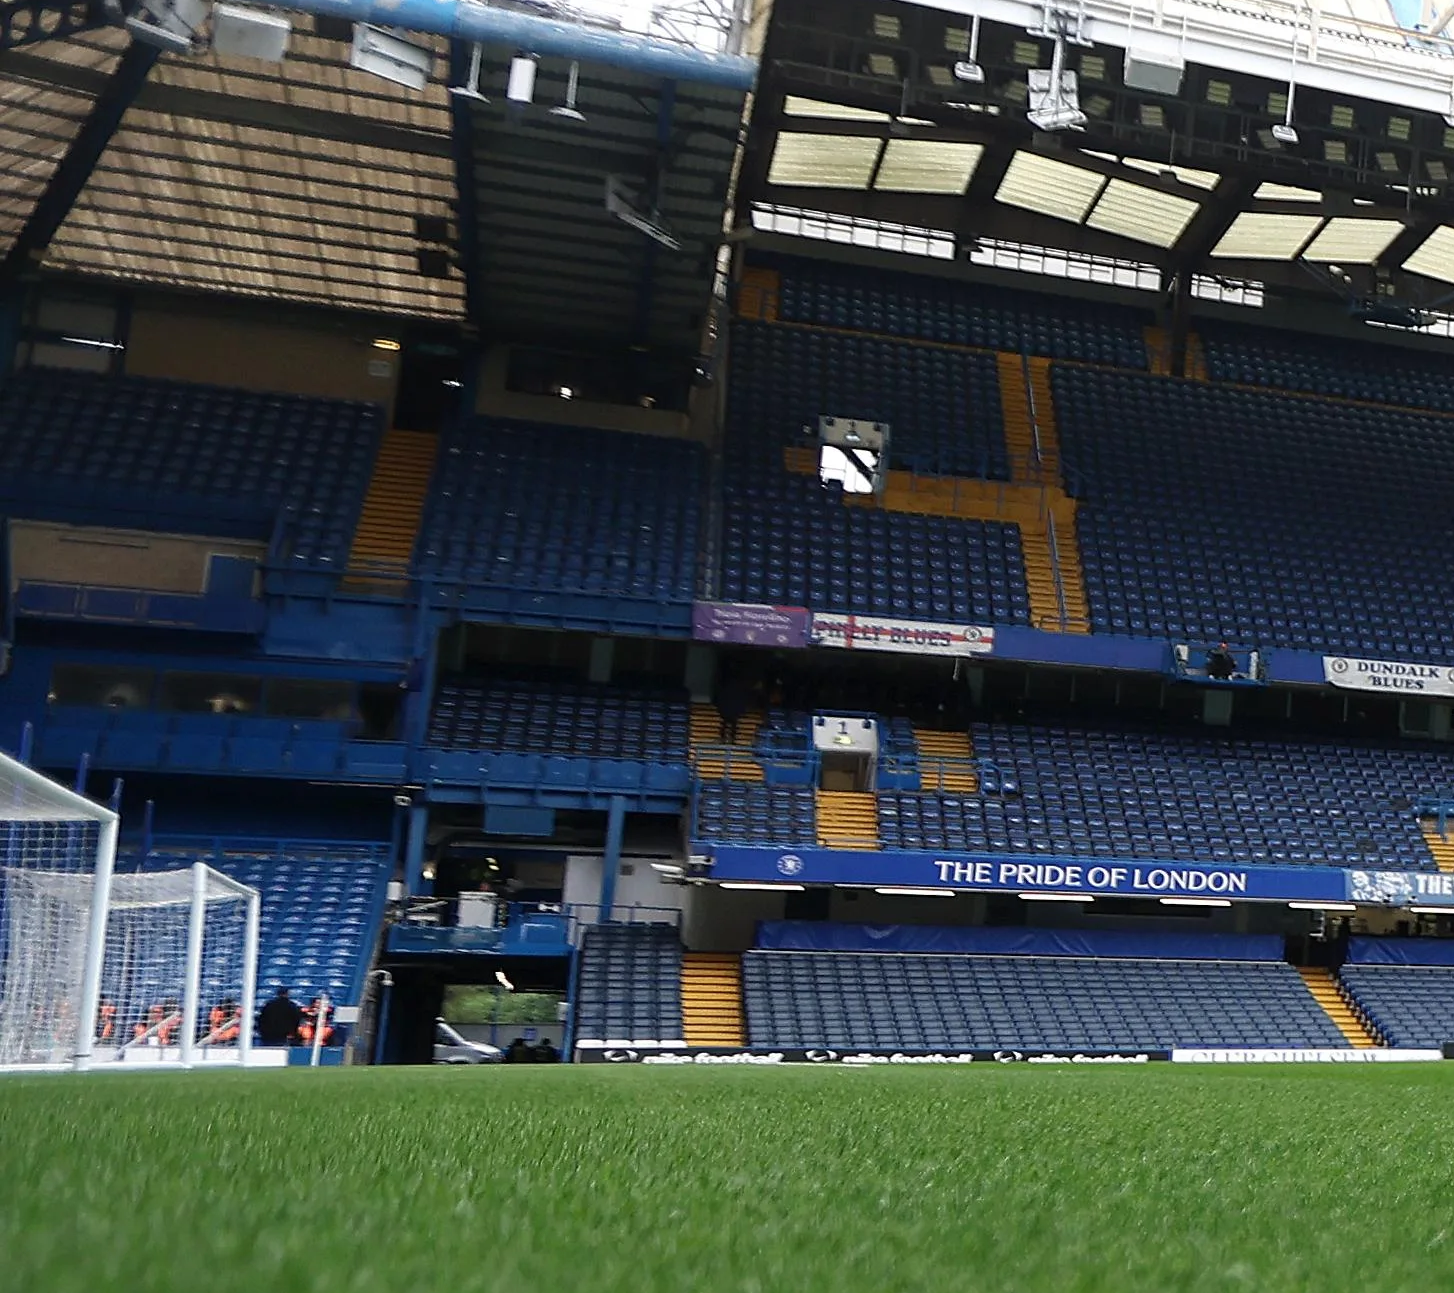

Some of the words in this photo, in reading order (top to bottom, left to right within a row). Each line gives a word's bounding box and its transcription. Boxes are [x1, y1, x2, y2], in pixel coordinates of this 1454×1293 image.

[1357, 661, 1440, 679] DUNDALK
[1370, 674, 1425, 690] BLUES
[838, 721, 848, 735] 1
[934, 860, 993, 884] THE
[998, 863, 1083, 887] PRIDE
[1087, 866, 1128, 888] OF
[1133, 868, 1247, 892] LONDON
